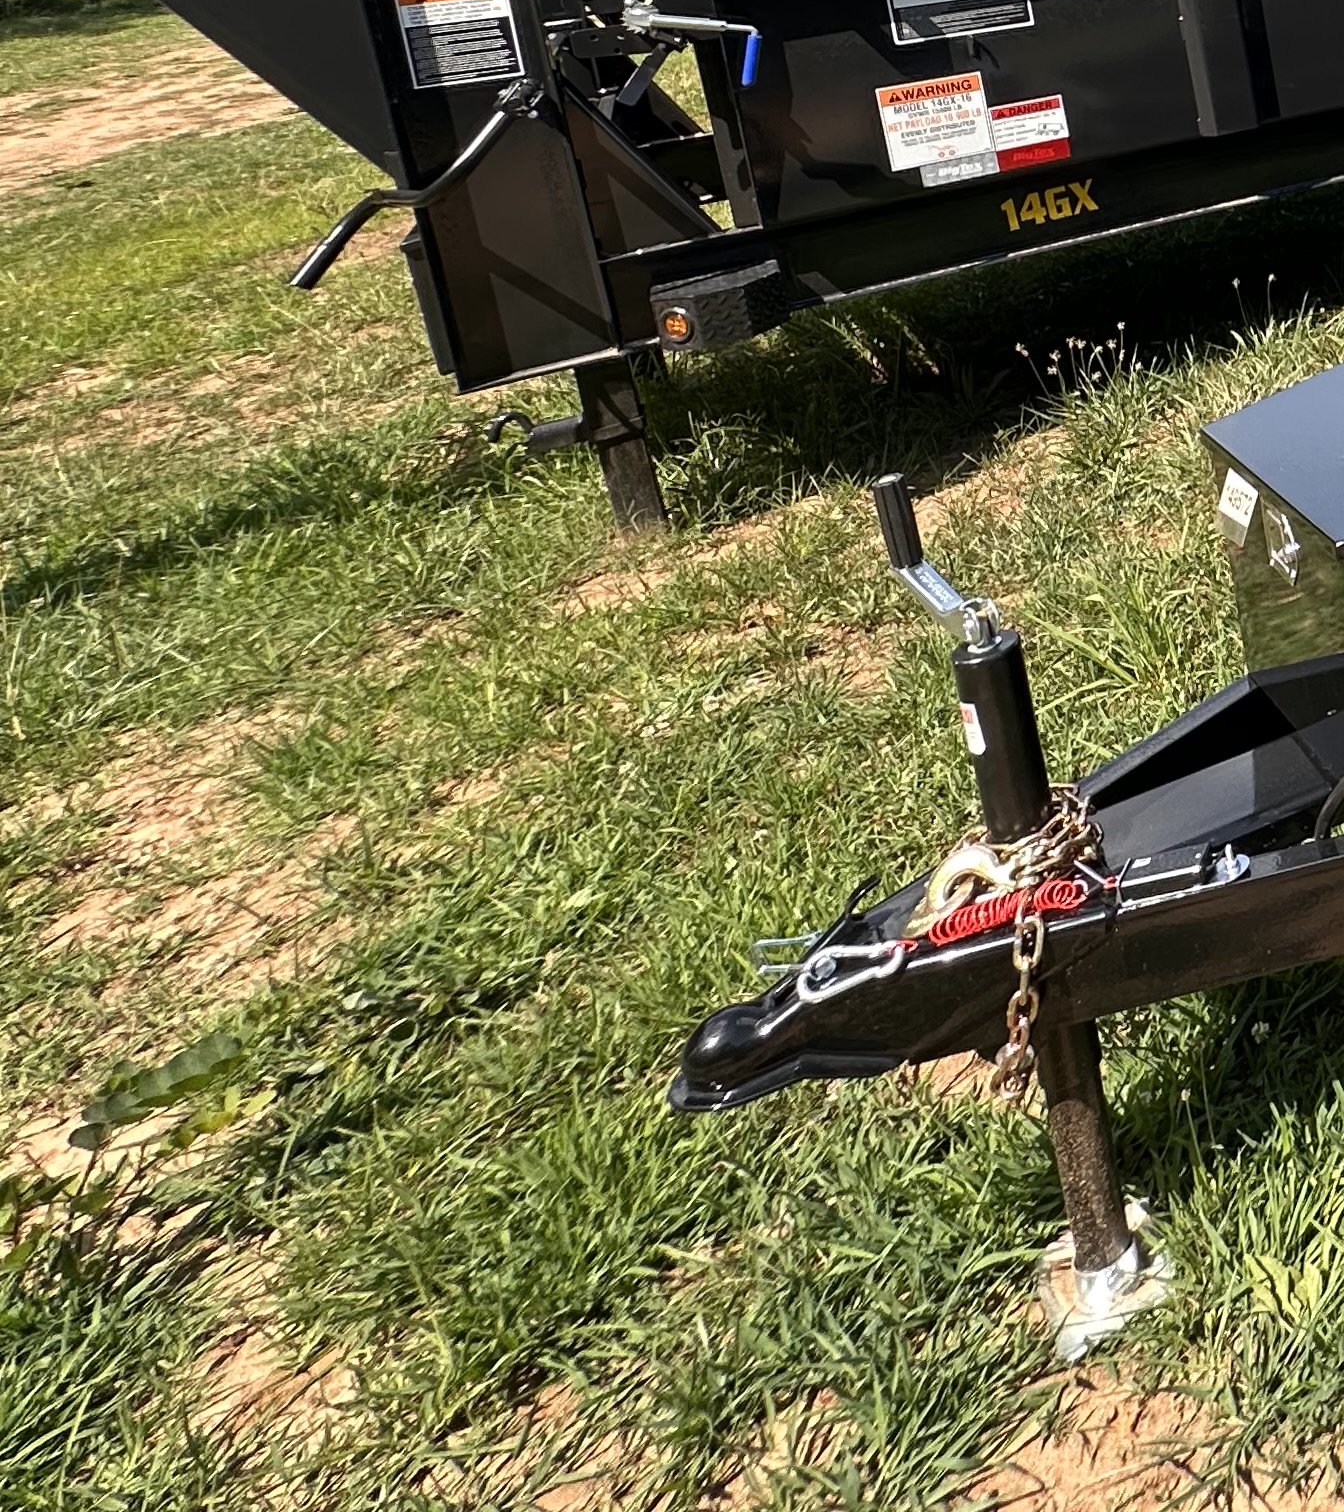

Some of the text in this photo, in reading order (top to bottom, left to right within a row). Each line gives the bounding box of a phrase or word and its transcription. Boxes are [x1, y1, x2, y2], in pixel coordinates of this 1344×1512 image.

[900, 79, 973, 101] WARNING
[893, 101, 929, 115] MODEL
[930, 92, 973, 107] 14GX-16
[1008, 101, 1053, 117] DANGER
[904, 116, 943, 129] PAYLOAD
[1000, 178, 1100, 232] 14GX
